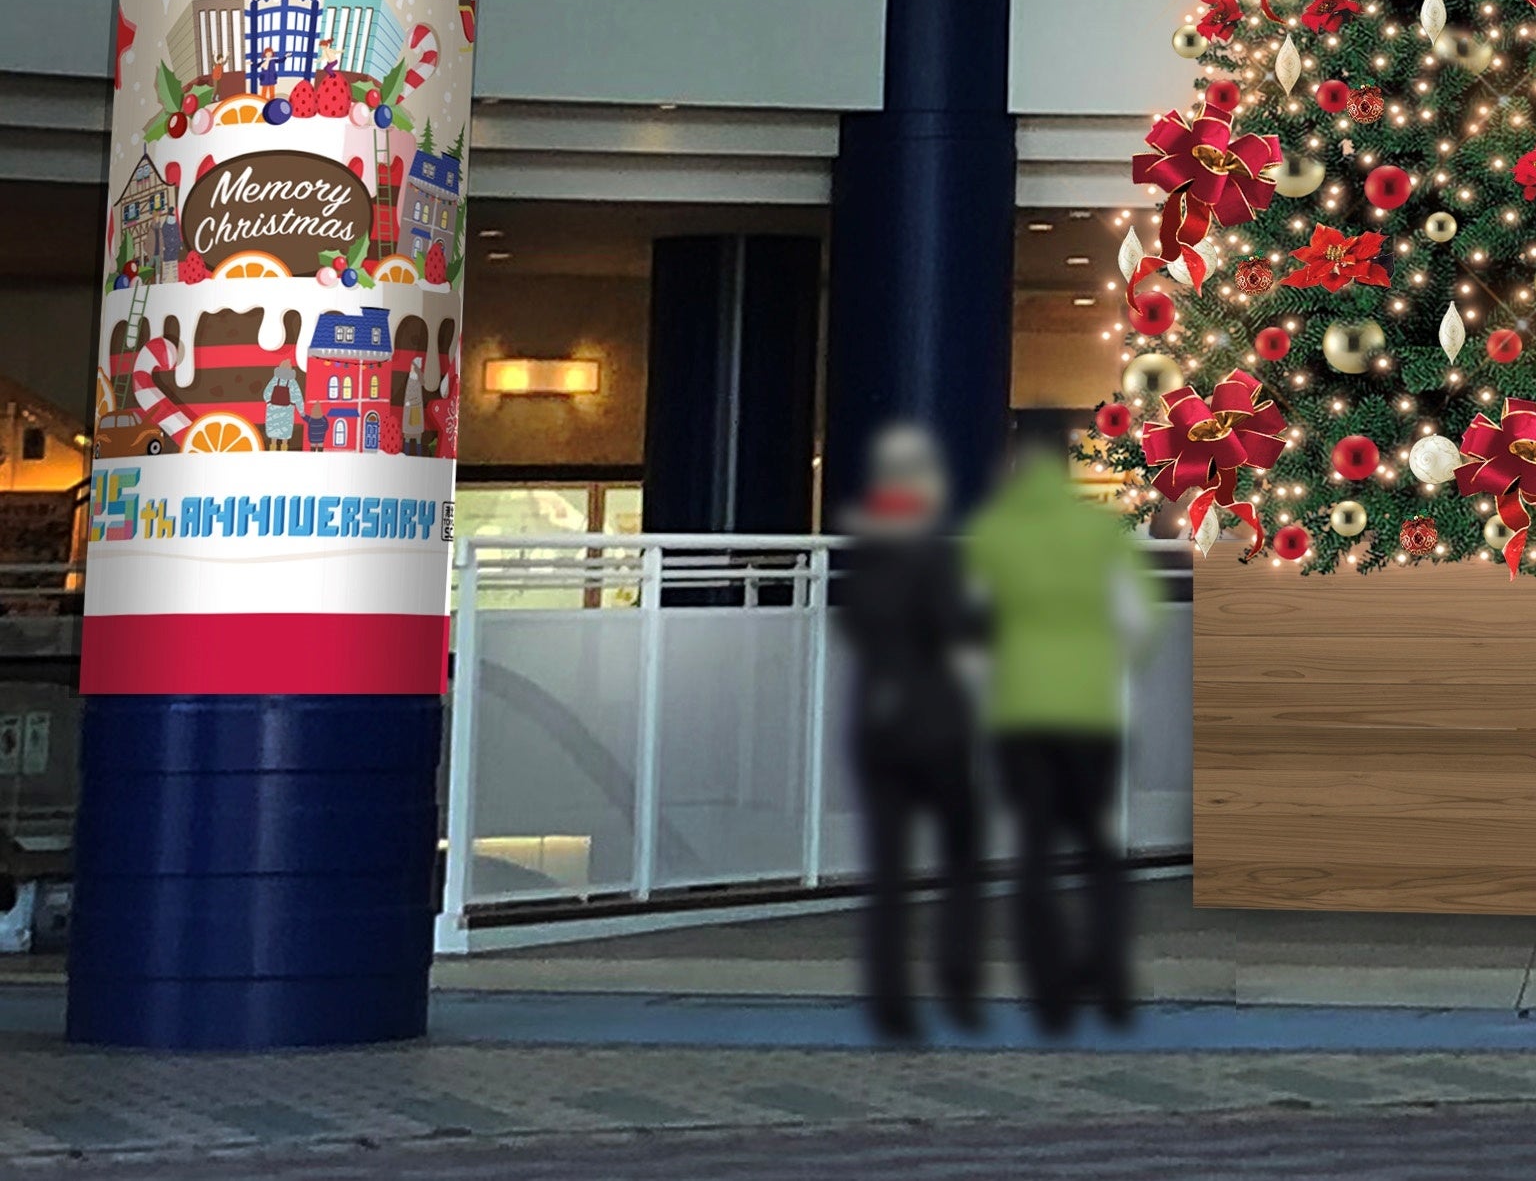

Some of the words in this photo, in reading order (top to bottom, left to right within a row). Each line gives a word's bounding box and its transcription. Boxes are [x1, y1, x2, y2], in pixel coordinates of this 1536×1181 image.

[210, 165, 352, 217] Memory
[195, 208, 355, 254] Christmas
[180, 496, 436, 539] ANNIVERSARY
